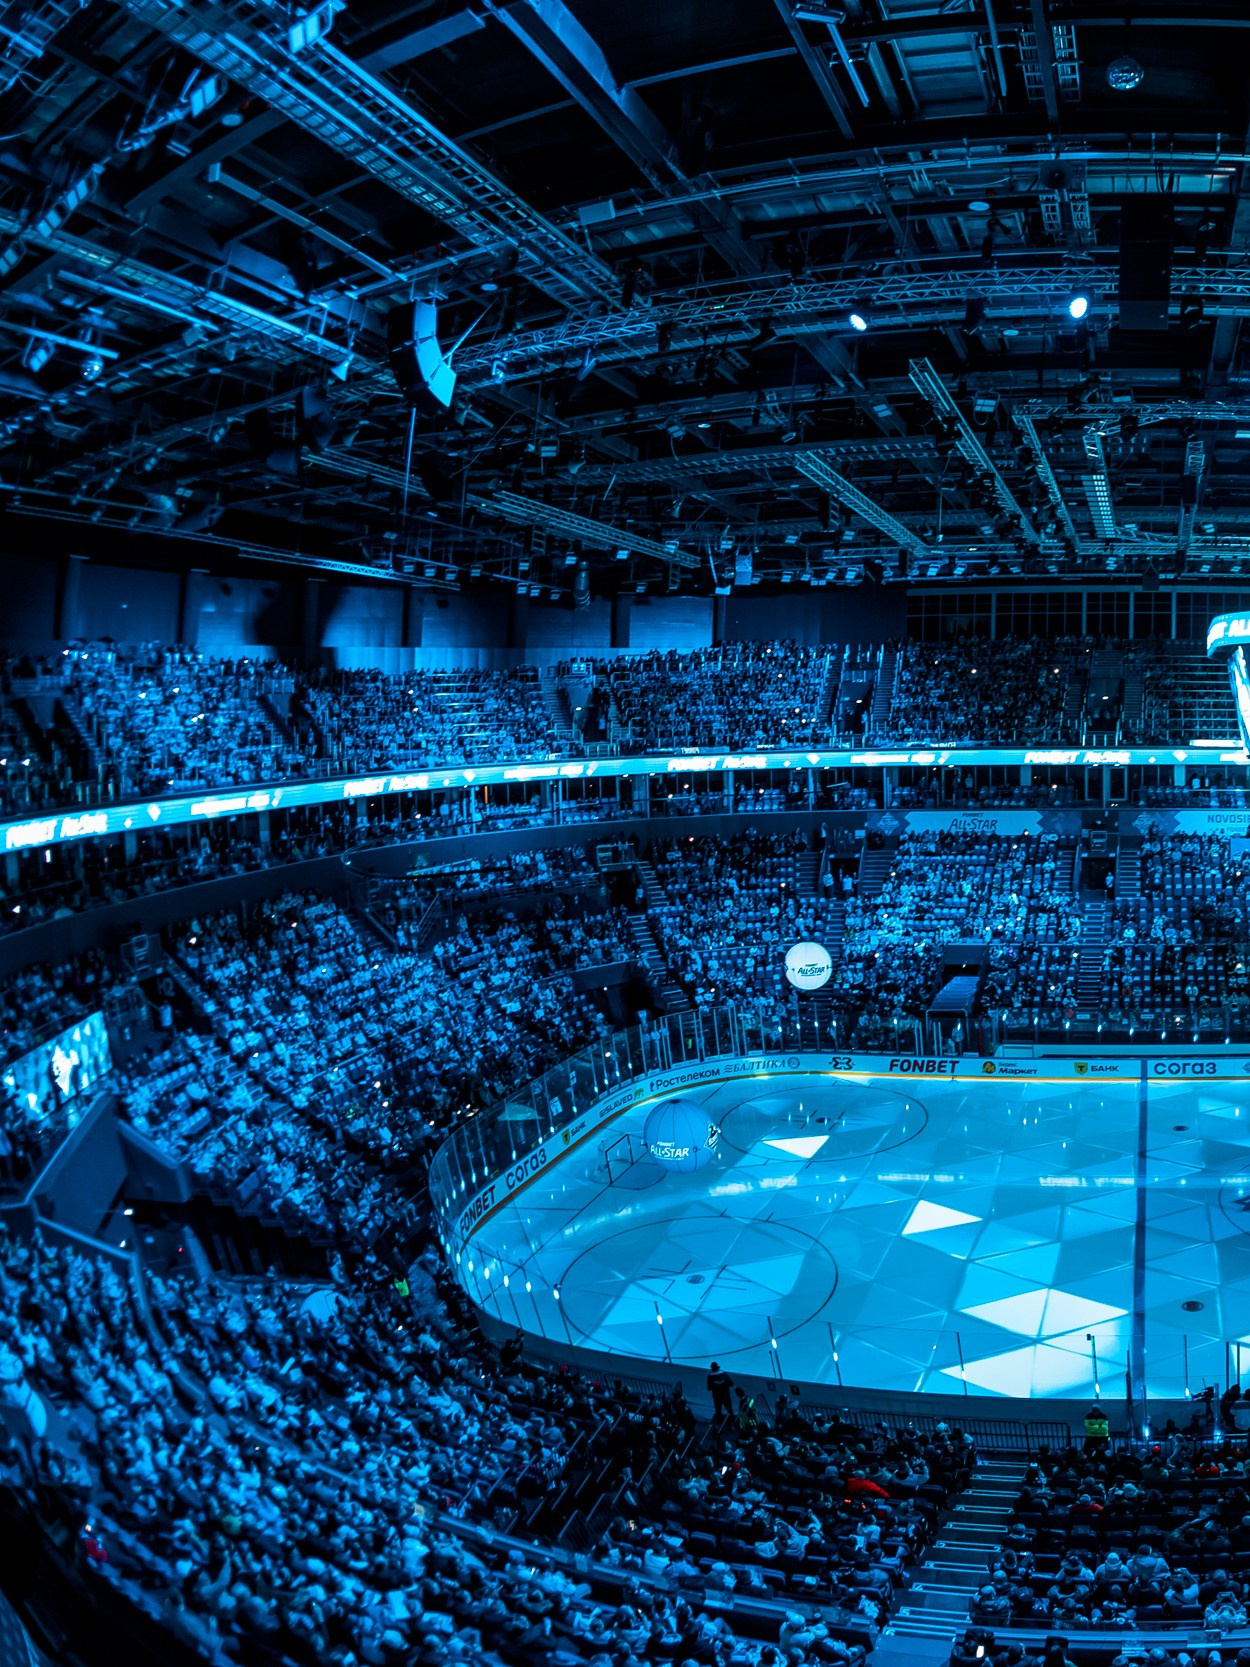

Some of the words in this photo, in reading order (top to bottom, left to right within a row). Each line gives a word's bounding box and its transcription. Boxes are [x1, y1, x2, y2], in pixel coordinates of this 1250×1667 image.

[733, 1058, 787, 1072] БАЛТИКА
[889, 1059, 960, 1074] FONBET
[655, 1067, 720, 1089] Ростелеком
[460, 1184, 496, 1233] FONBET
